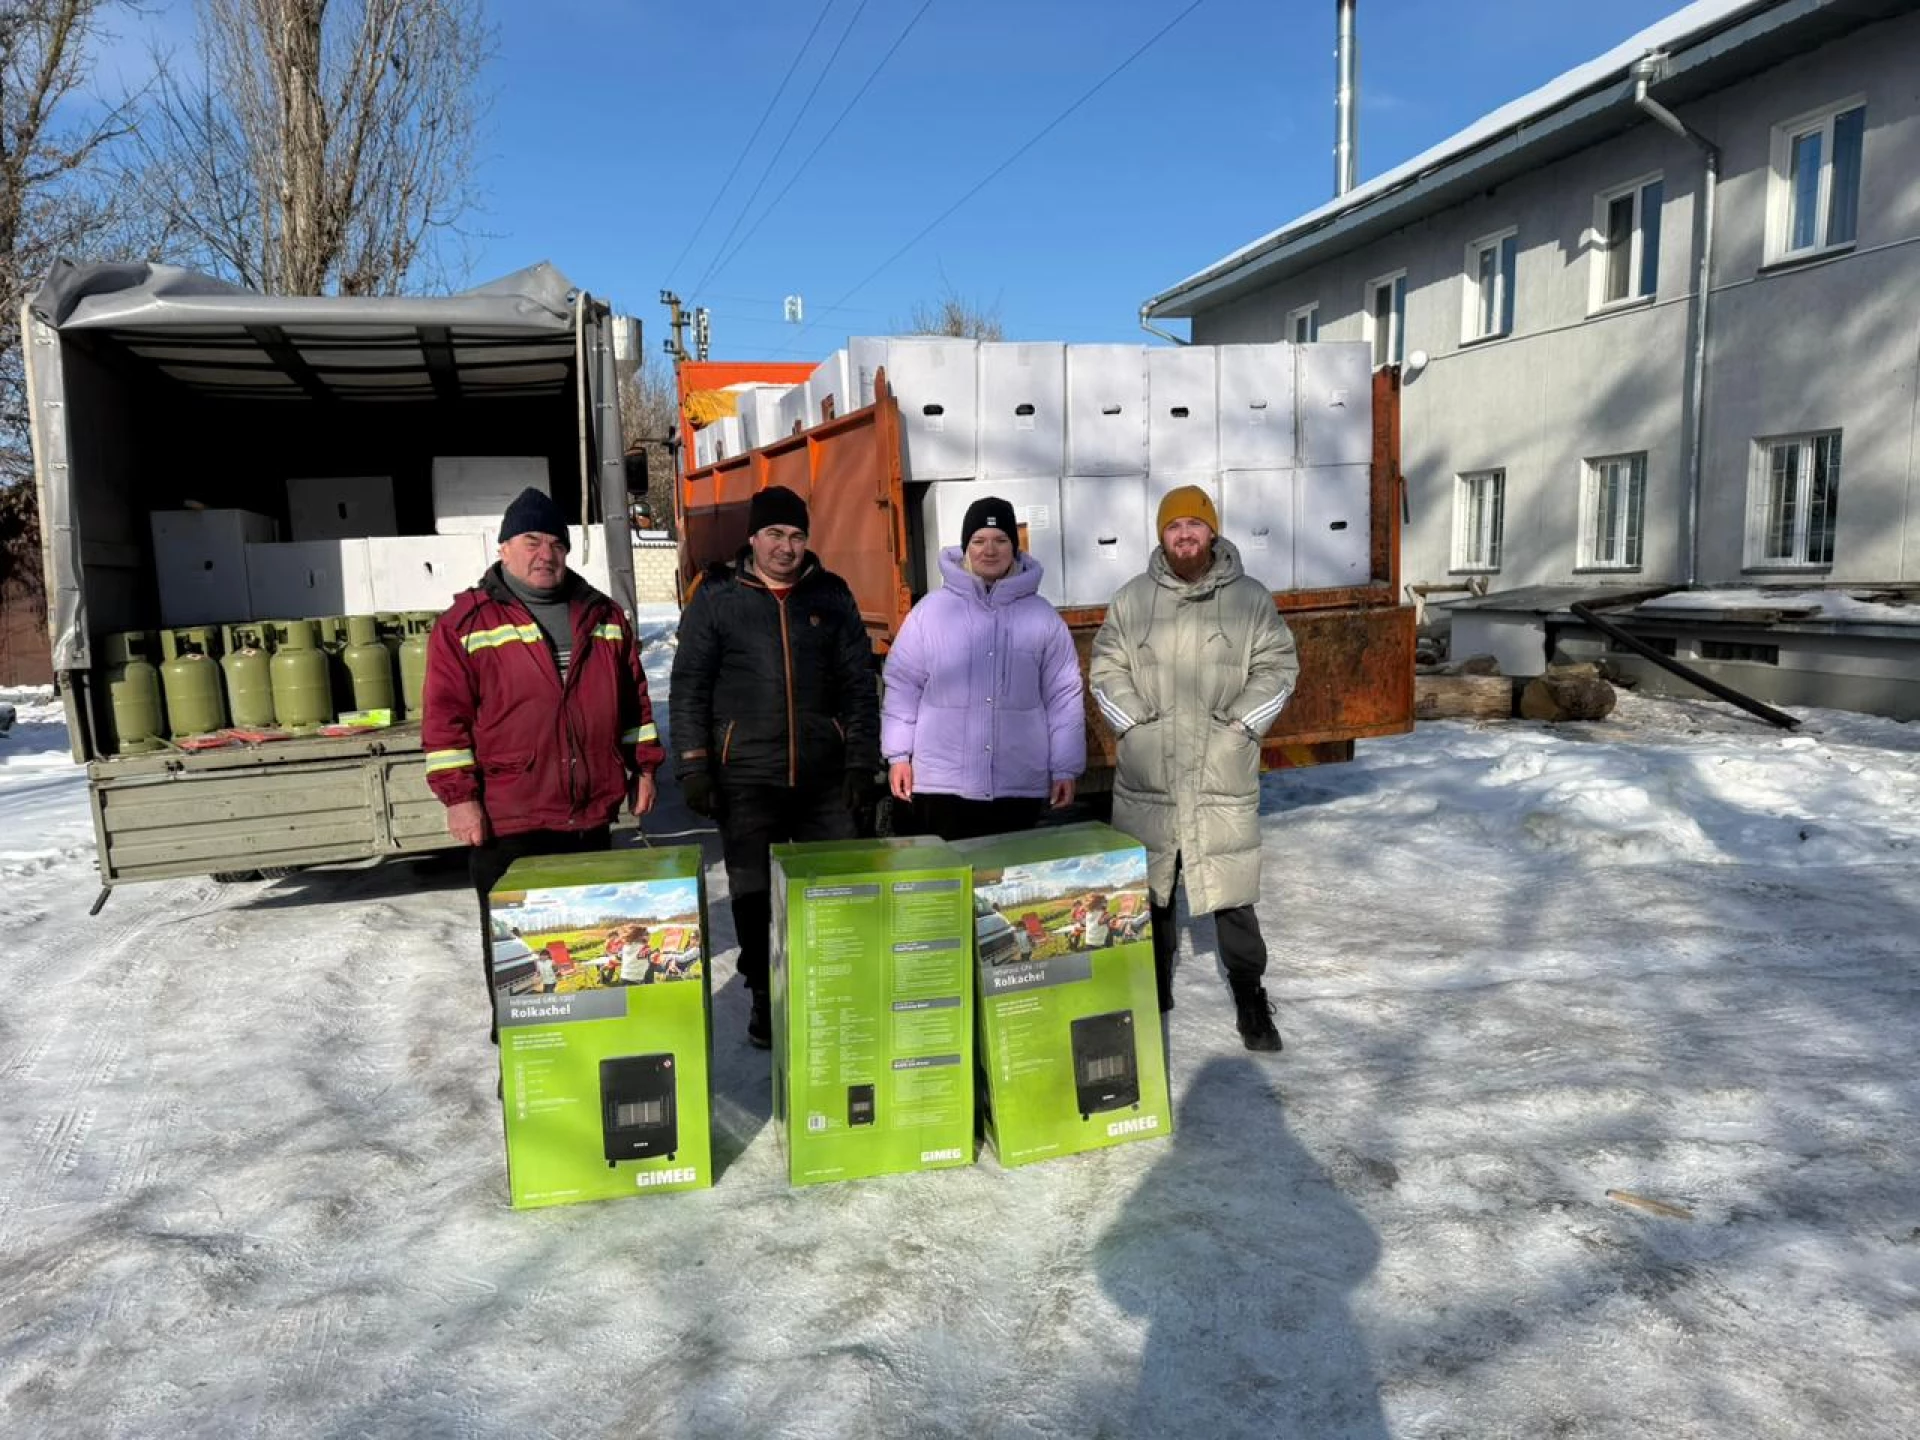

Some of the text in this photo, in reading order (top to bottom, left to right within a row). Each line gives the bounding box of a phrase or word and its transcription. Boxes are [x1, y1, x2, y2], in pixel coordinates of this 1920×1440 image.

[994, 970, 1045, 988] Rolkachel
[510, 1003, 571, 1018] Rolkachel
[1107, 1116, 1158, 1137] GIMEG
[920, 1148, 961, 1162] GIMEG
[636, 1167, 696, 1186] GIMEG
